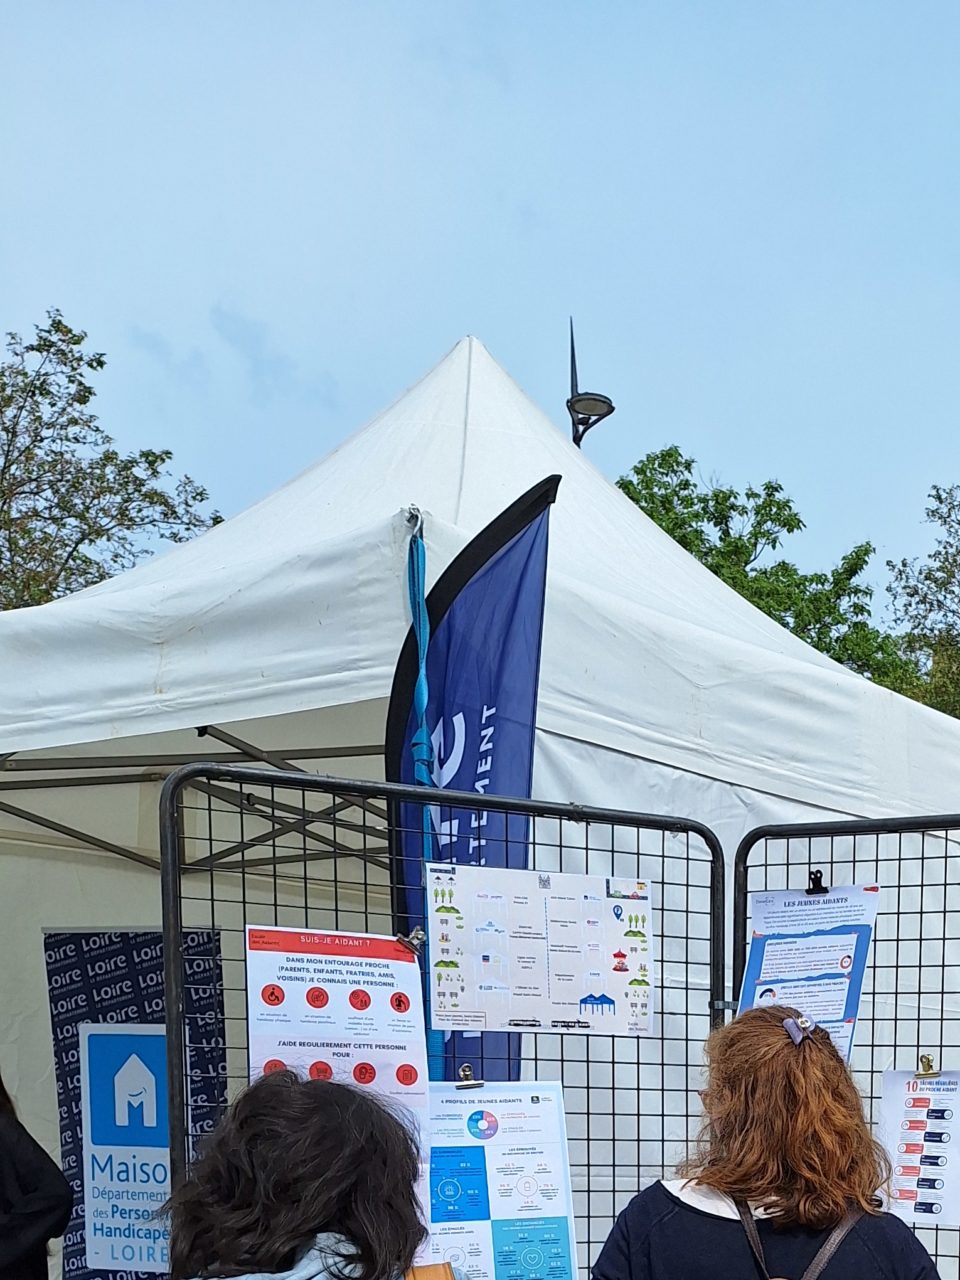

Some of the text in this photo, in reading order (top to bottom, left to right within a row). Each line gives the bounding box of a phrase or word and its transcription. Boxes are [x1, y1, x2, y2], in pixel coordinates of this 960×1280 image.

[300, 935, 332, 944] SUIS-JE
[334, 938, 364, 946] AIDANT
[87, 955, 127, 976] Loire
[286, 956, 305, 964] DANS
[324, 959, 364, 968] ENTOURAGE
[365, 961, 390, 969] PROCHE
[313, 967, 345, 976] ENFANTS,
[346, 969, 377, 978] FRATRIES,
[316, 977, 348, 985] CONNAIS
[362, 980, 395, 988] PERSONNE
[93, 981, 133, 1002] Loire
[51, 994, 87, 1015] Loire
[298, 1041, 352, 1049] REGULIEREMENT
[374, 1043, 407, 1051] PERSONNE
[905, 1080, 918, 1093] 10
[93, 1208, 108, 1219] des
